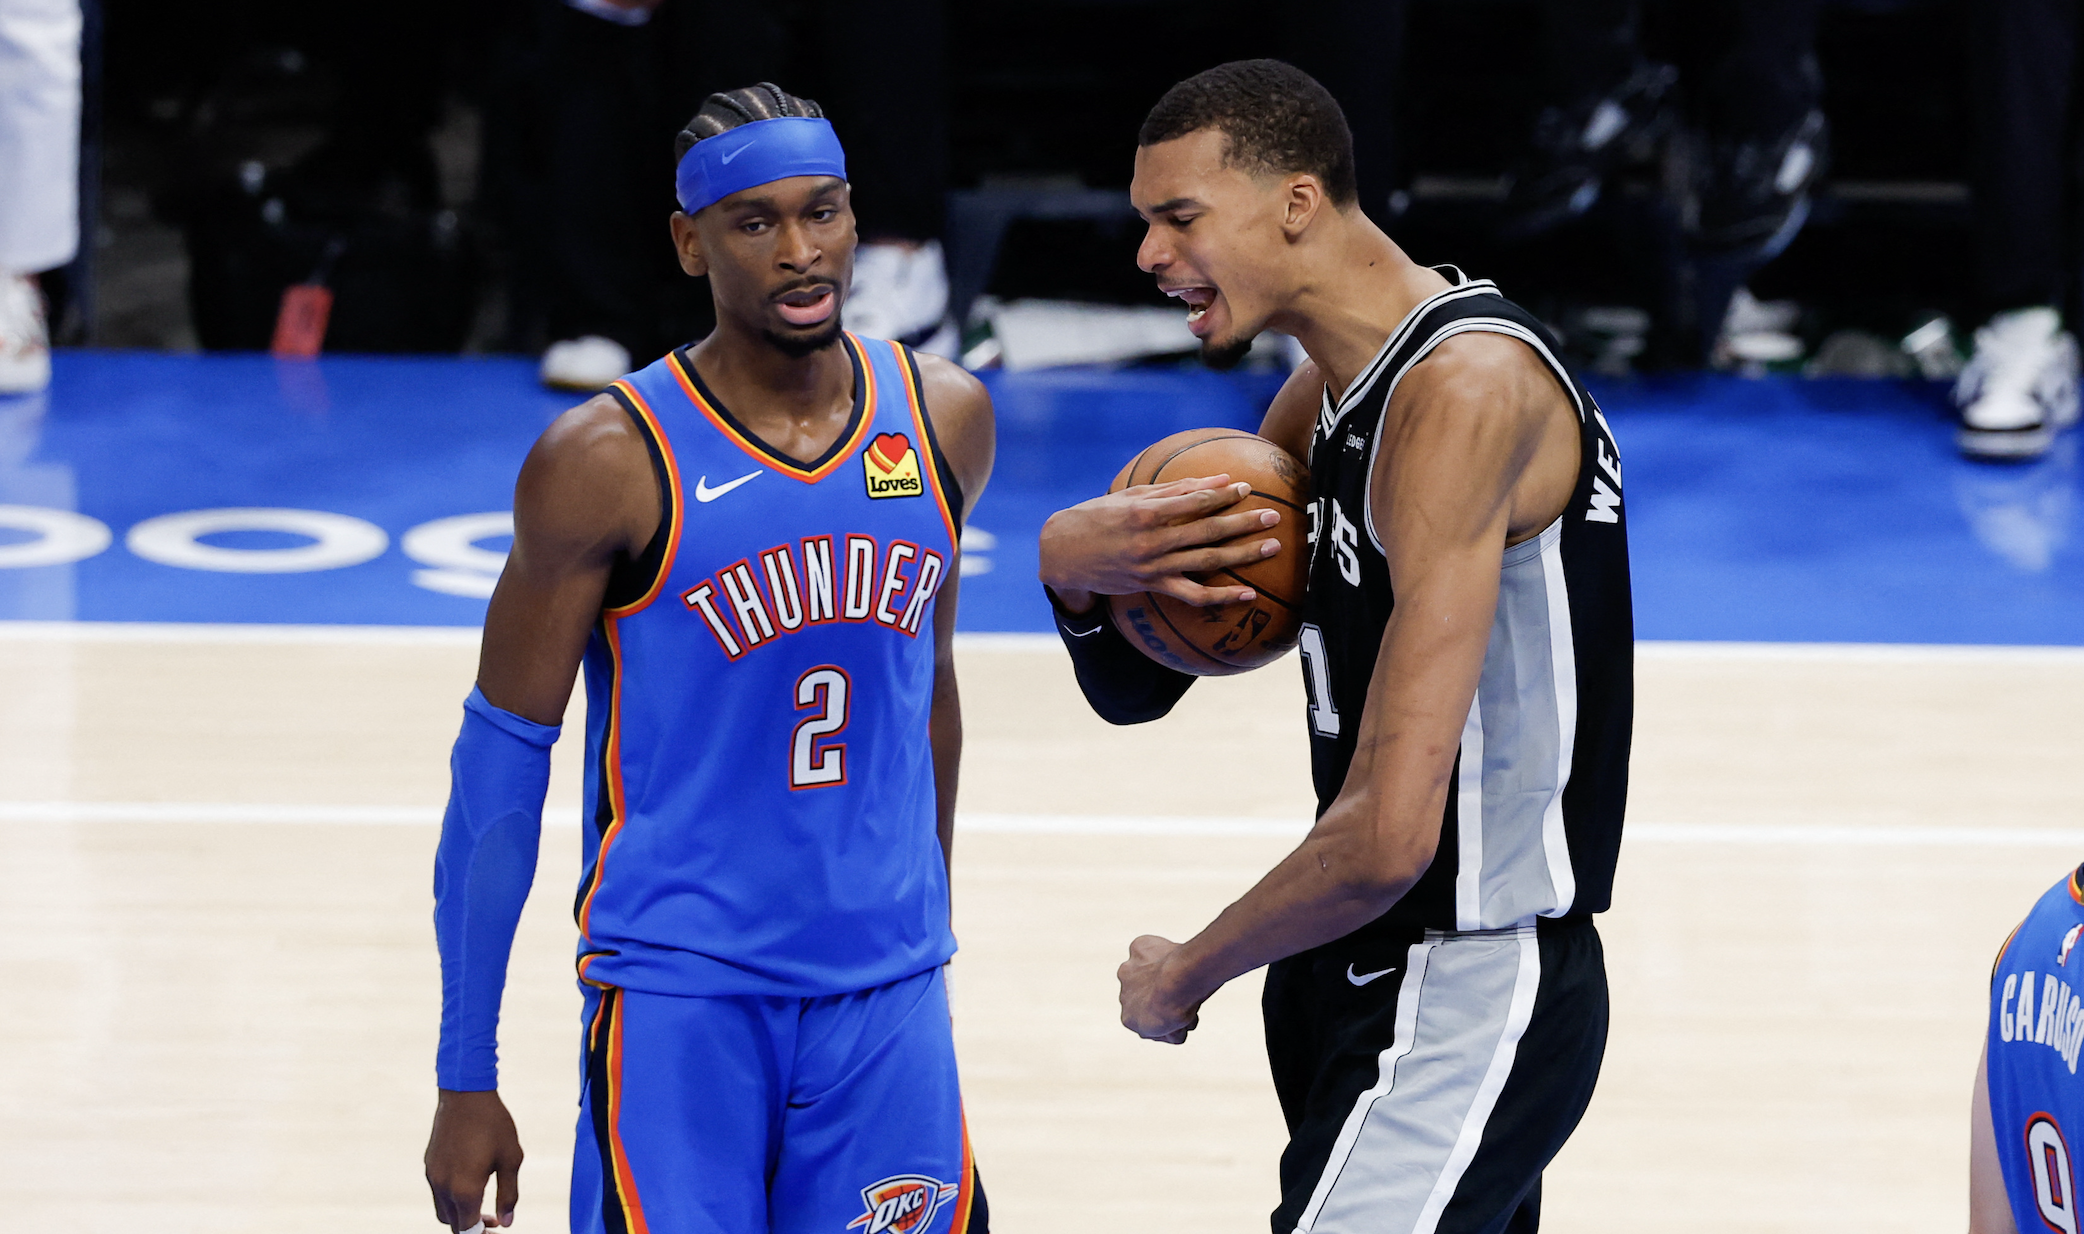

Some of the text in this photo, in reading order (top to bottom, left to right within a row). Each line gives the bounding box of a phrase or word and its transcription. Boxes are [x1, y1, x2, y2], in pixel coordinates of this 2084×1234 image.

[681, 533, 943, 662] THUNDER
[789, 664, 852, 791] 2
[1299, 622, 1341, 738] 1
[868, 1187, 925, 1234] OKC
[2023, 1111, 2082, 1234] 9
